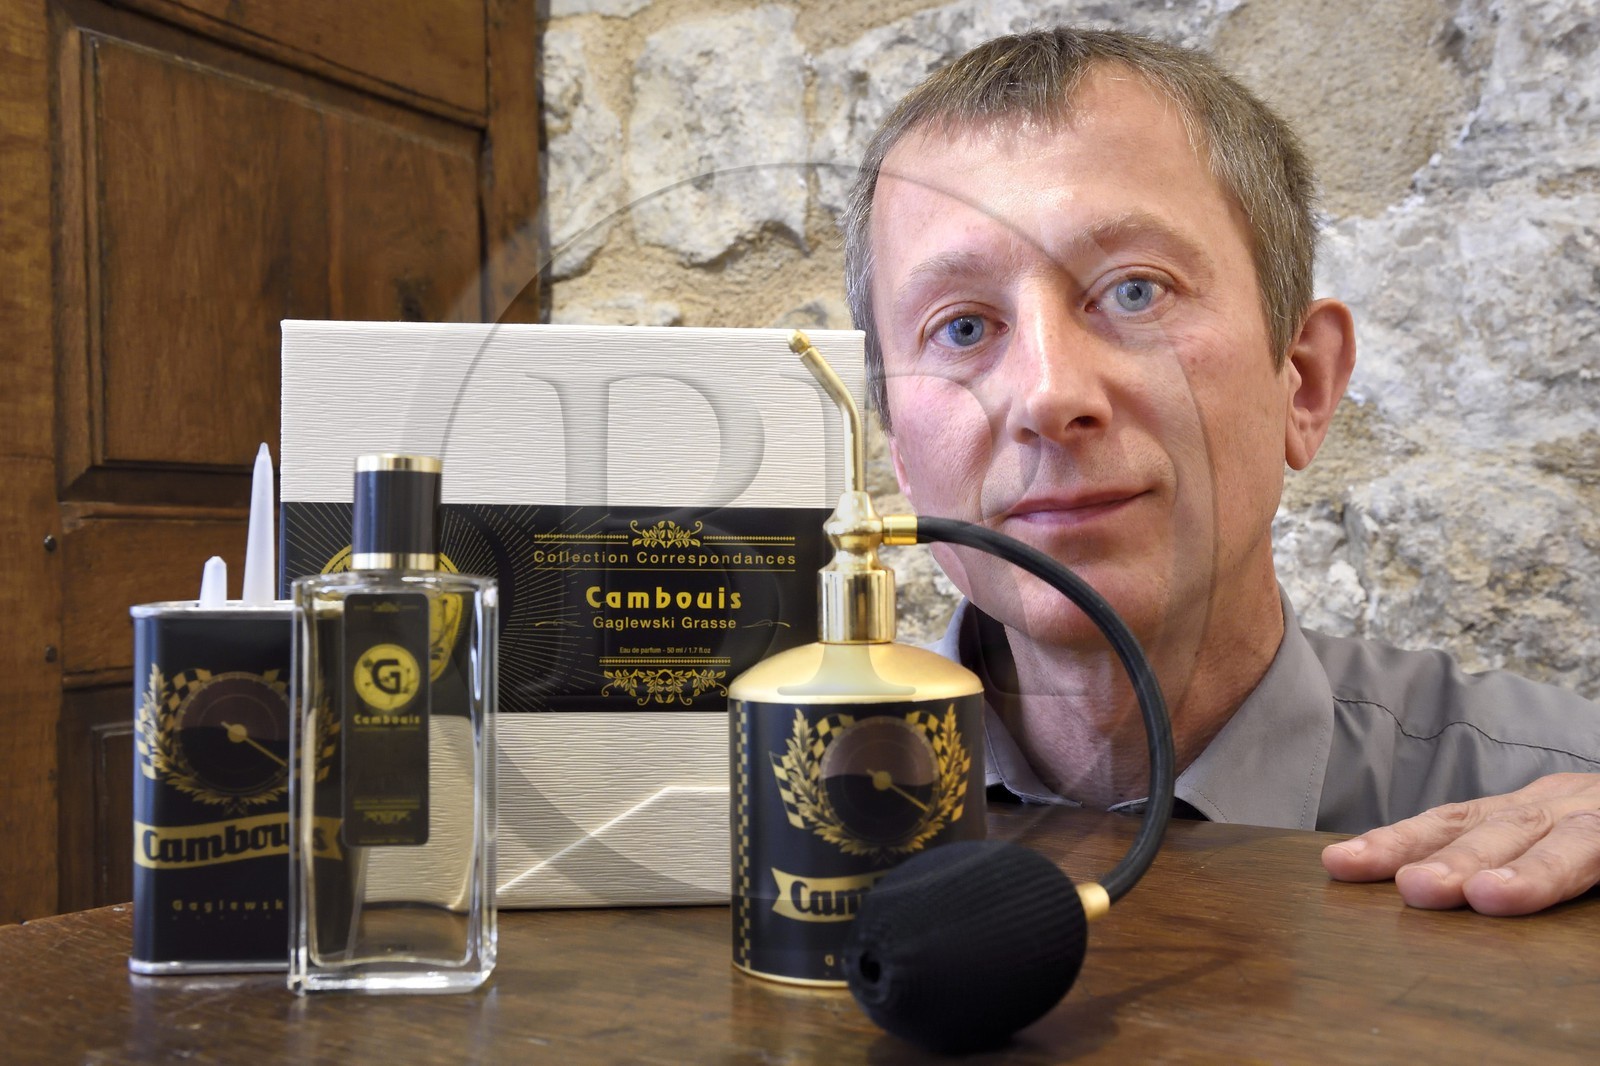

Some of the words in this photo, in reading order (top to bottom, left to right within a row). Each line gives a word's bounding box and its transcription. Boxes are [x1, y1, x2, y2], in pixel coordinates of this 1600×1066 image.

[533, 550, 629, 563] Collection
[636, 551, 796, 566] Correspondances
[585, 586, 742, 609] Cambouis
[592, 616, 675, 631] Gaglewski
[681, 617, 737, 629] Grasse
[619, 646, 631, 654] Eau
[631, 646, 640, 654] de
[640, 646, 662, 655] parfum
[675, 646, 684, 654] ml
[371, 659, 401, 694] G
